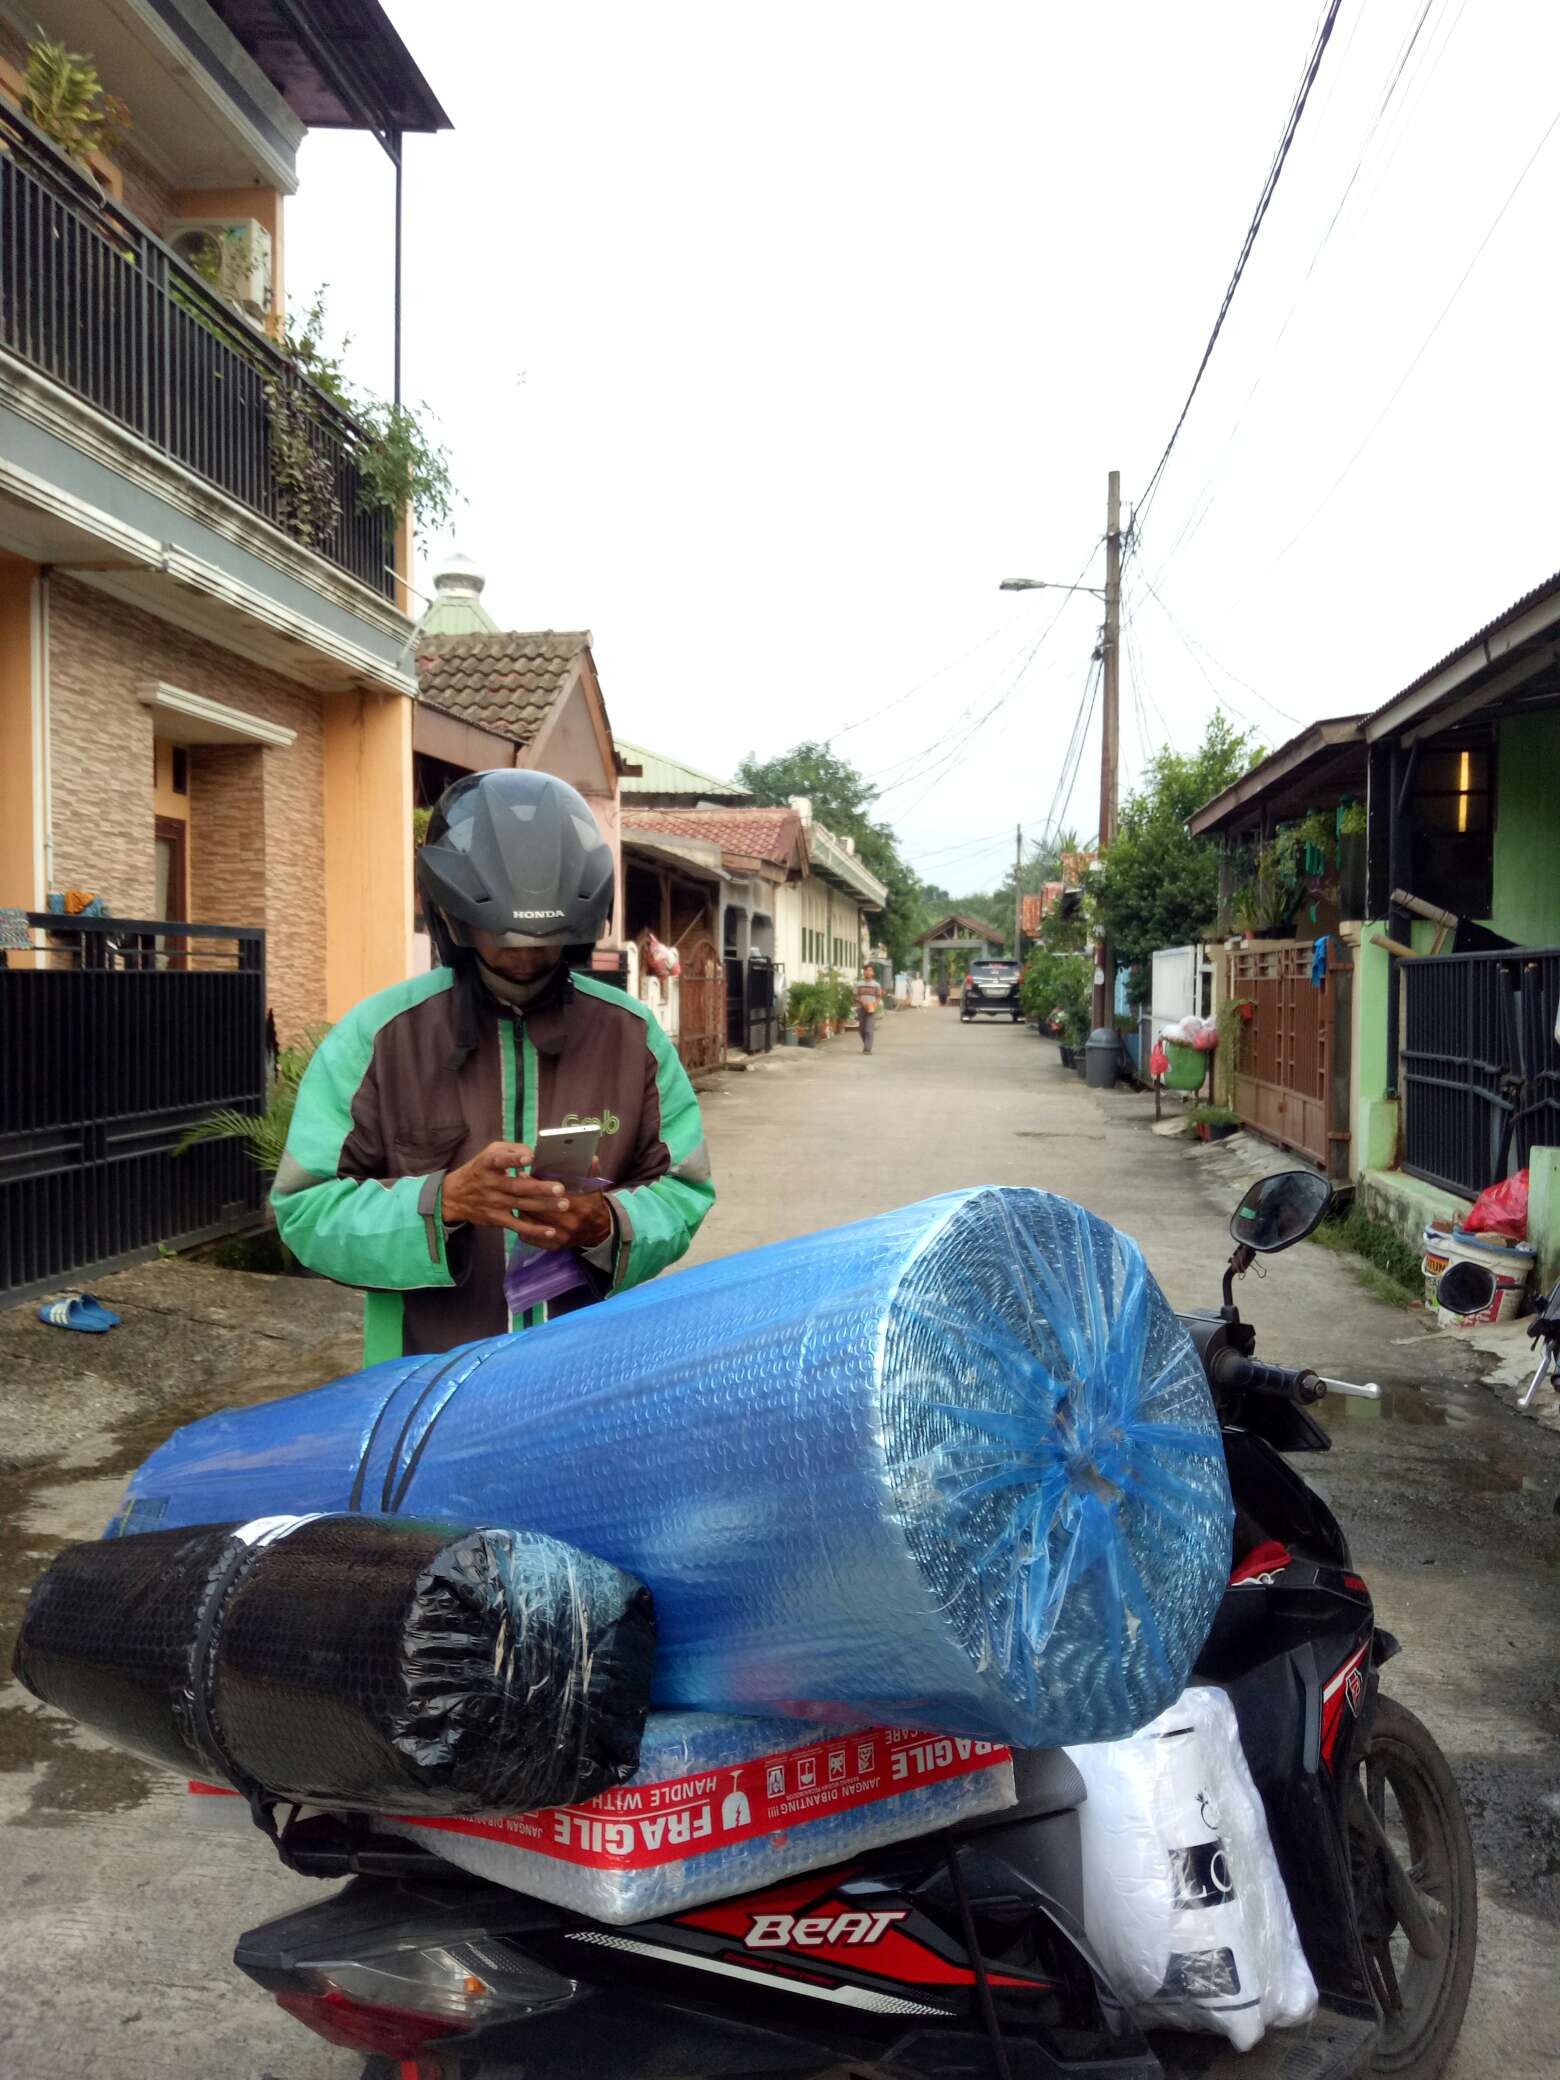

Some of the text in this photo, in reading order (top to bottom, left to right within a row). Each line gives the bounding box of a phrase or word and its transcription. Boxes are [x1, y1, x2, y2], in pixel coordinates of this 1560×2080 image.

[513, 910, 565, 919] HONDA
[892, 1737, 1008, 1780] RAGILE
[651, 1776, 717, 1806] HANDLE
[842, 1776, 880, 1797] JANGAN
[507, 1819, 543, 1839] JANGAN
[554, 1805, 713, 1855] FRAGILE
